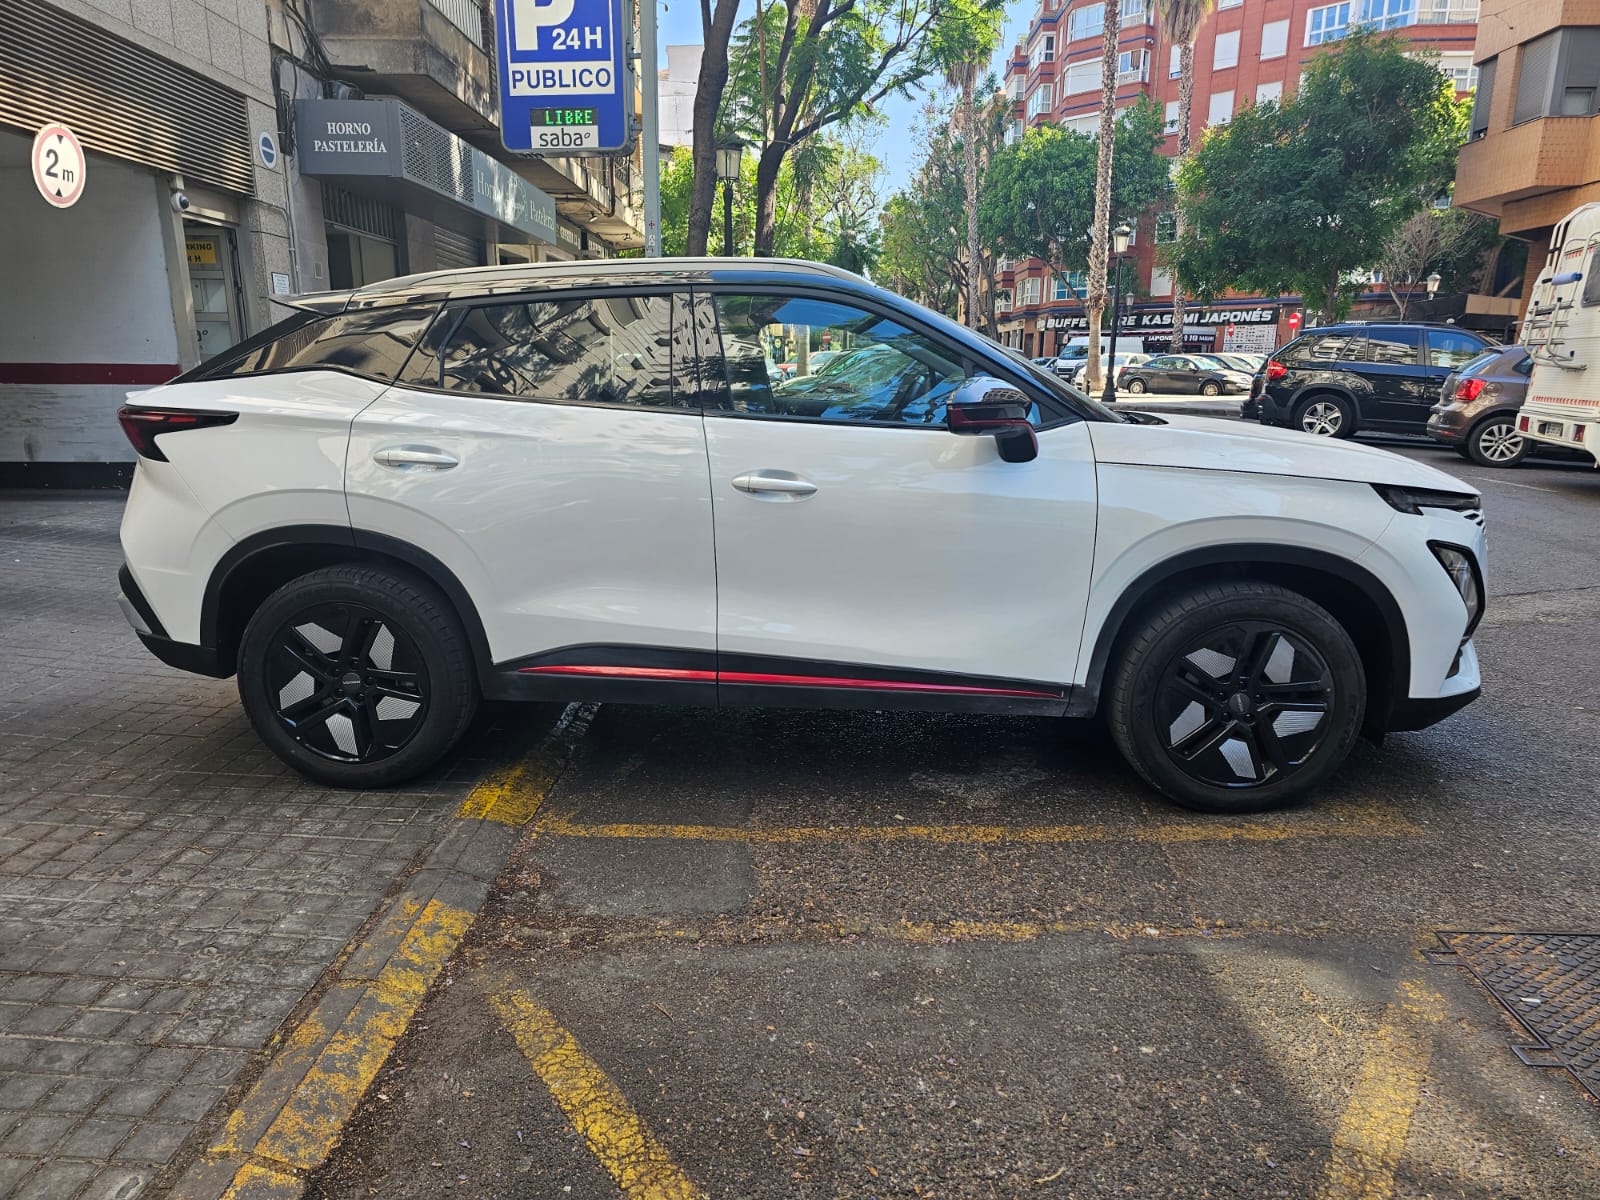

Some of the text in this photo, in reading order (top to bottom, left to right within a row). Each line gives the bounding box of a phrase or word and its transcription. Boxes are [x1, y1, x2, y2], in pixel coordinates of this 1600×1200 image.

[513, 0, 575, 51] P
[511, 67, 611, 89] PUBLICO
[545, 110, 593, 124] LIBRE
[327, 122, 371, 135] HORNO
[313, 138, 387, 153] PASTELERÍA
[1047, 318, 1088, 328] BUFFE
[1201, 308, 1273, 323] JAPONÉS
